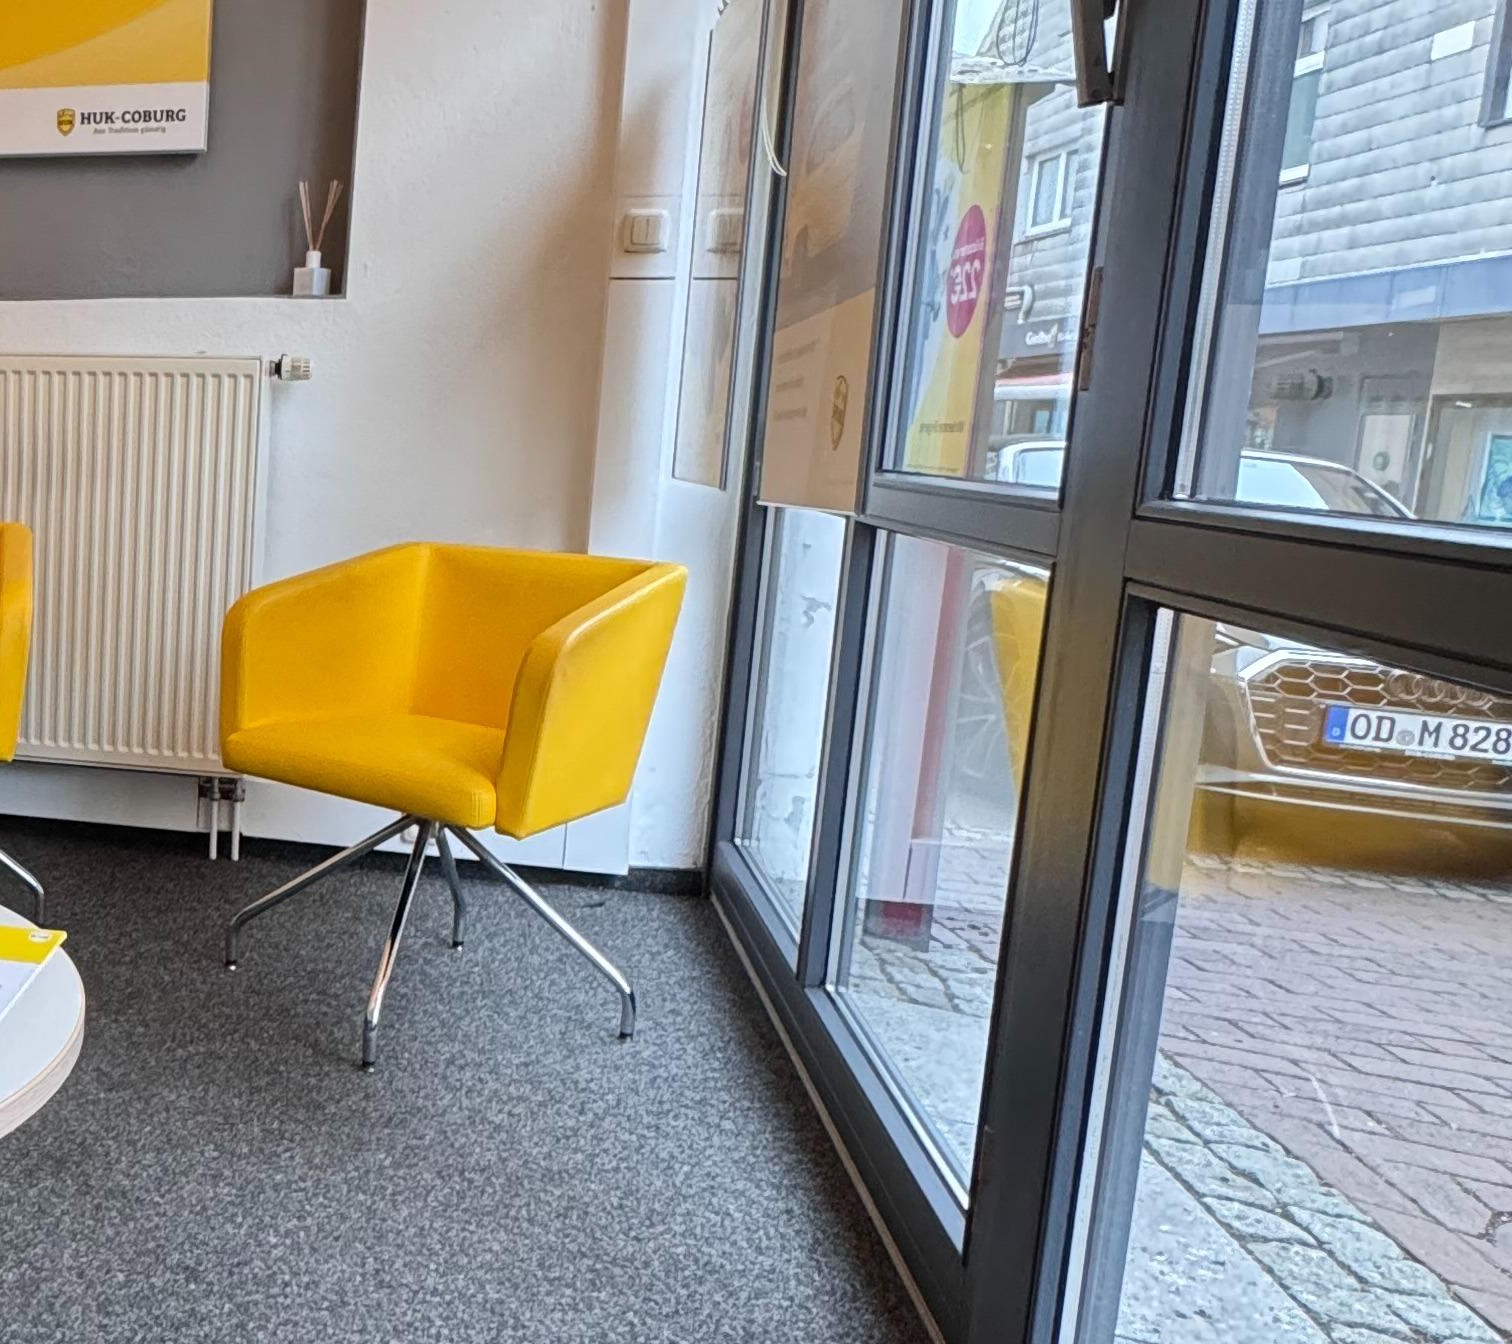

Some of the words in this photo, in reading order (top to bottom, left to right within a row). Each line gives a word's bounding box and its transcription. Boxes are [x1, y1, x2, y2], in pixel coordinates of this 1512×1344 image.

[80, 108, 187, 125] HUK-COBURG
[1349, 712, 1396, 743] OD
[1418, 719, 1444, 748] M
[1448, 723, 1512, 755] 828
